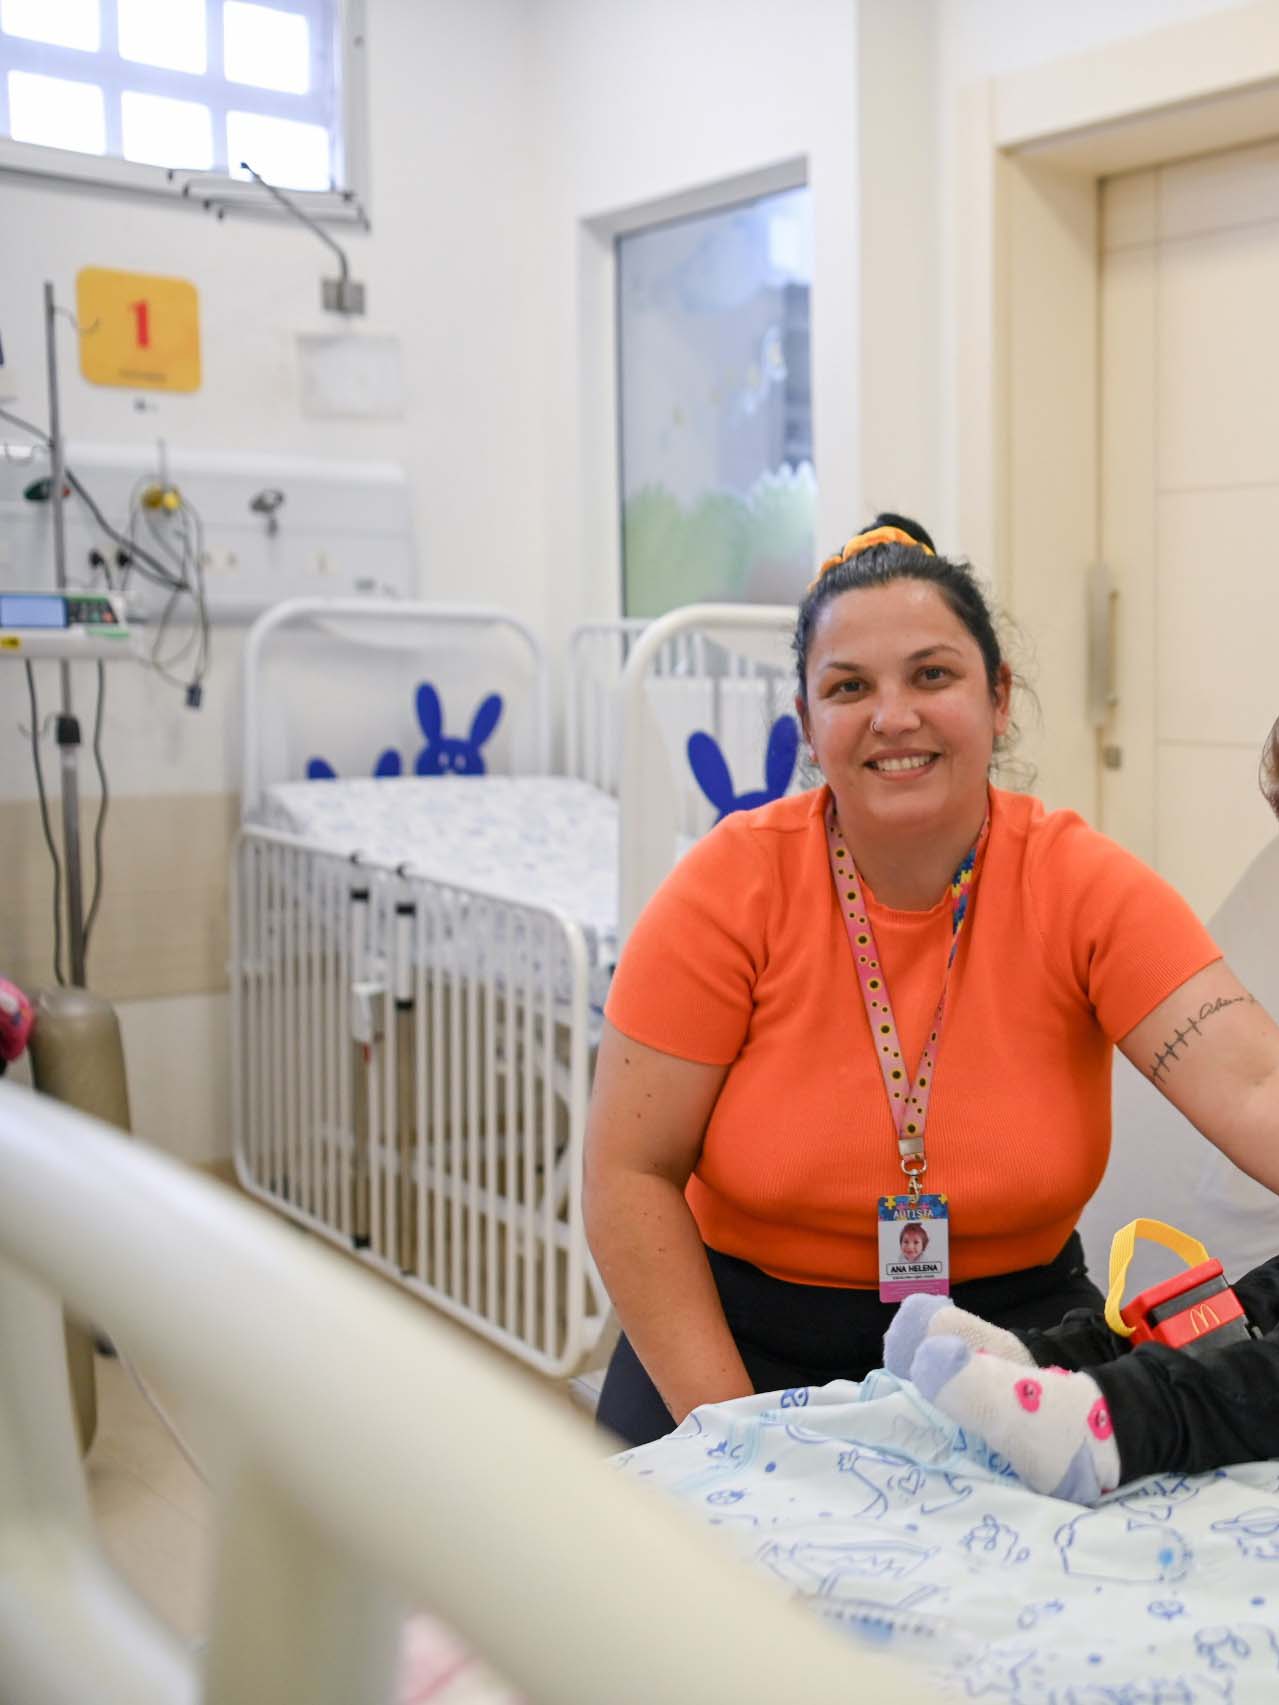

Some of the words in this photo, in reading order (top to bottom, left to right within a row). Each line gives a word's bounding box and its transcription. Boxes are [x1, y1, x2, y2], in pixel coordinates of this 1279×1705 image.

[129, 299, 150, 348] 1
[893, 1209, 934, 1219] AUTISTA
[890, 1265, 907, 1273] ANA
[908, 1264, 938, 1272] HELENA
